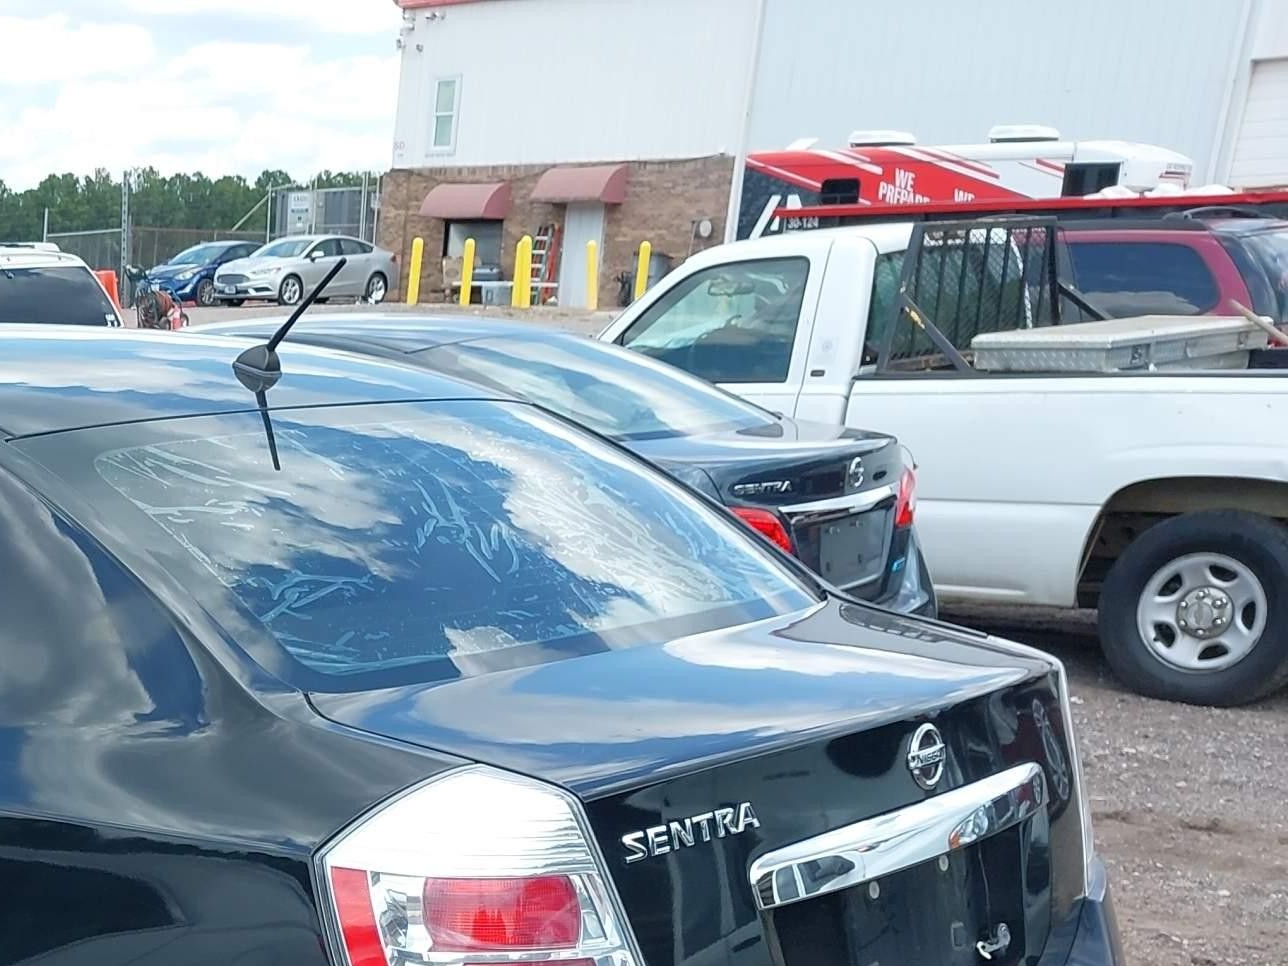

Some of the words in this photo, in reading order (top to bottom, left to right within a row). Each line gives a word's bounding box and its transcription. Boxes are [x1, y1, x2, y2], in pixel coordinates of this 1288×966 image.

[895, 168, 916, 192] WE
[733, 480, 792, 495] SENTRA
[621, 802, 761, 864] SENTRA
